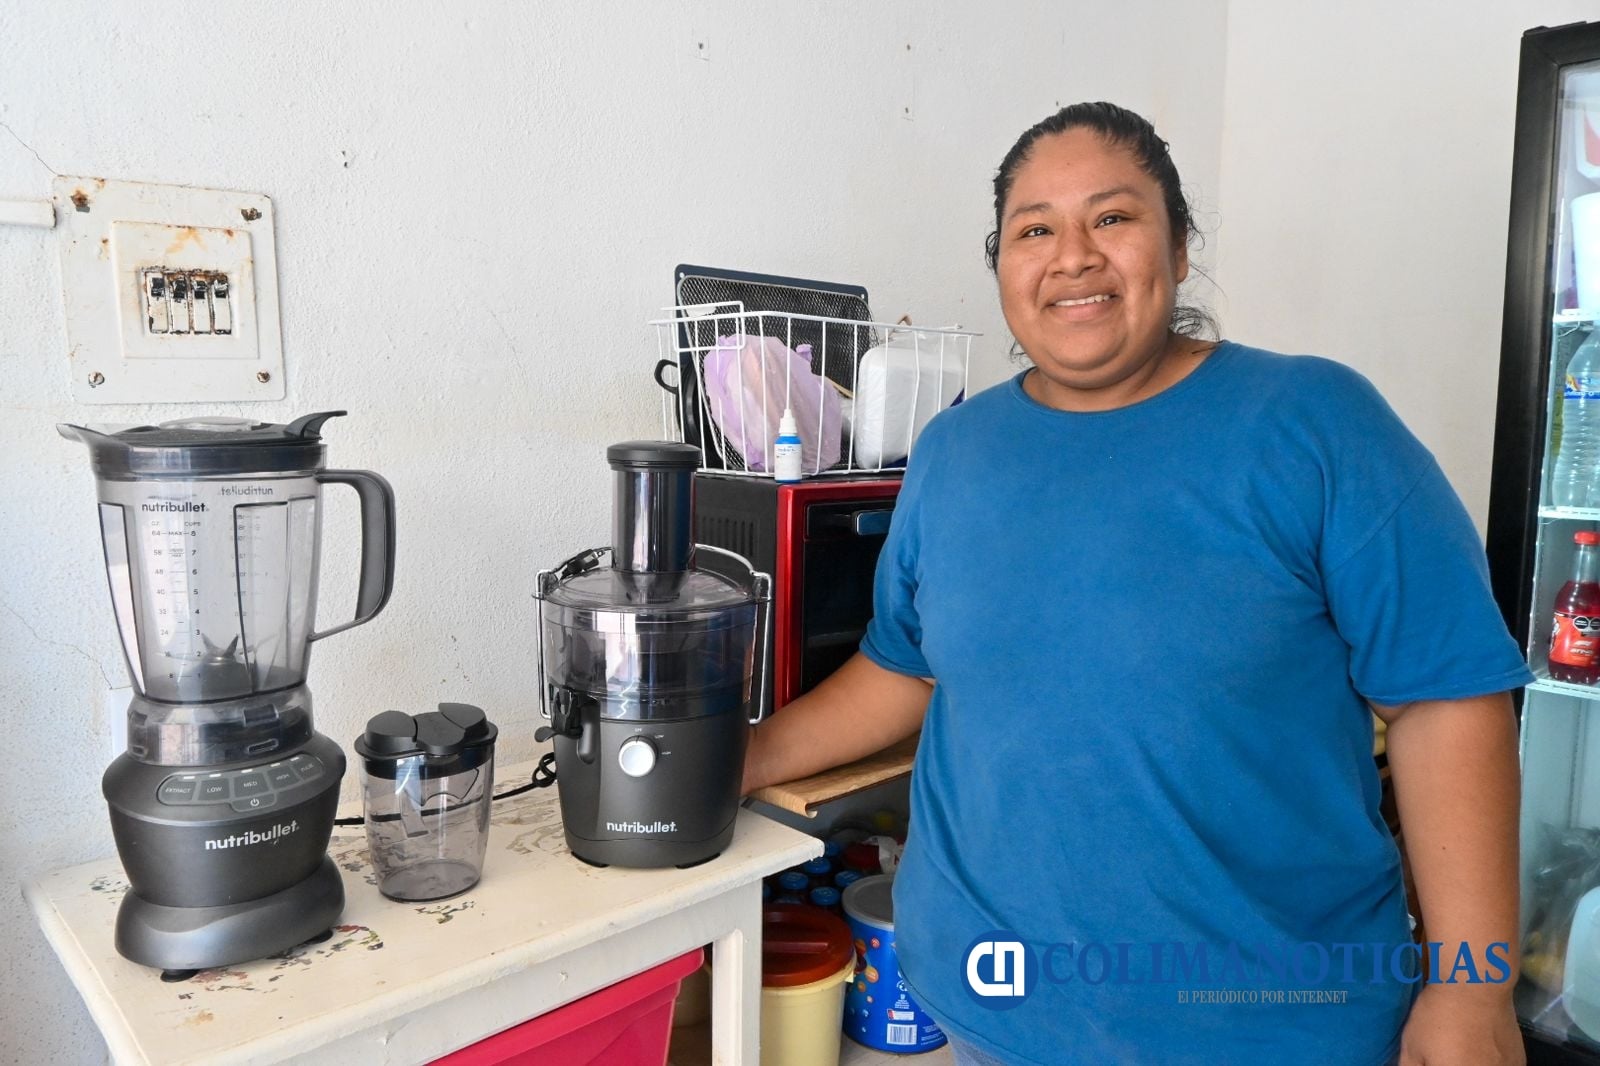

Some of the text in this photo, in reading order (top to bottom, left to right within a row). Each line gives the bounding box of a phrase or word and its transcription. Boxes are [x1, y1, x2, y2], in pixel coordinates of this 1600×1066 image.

[142, 502, 206, 512] nutribullet
[606, 821, 676, 834] nutribullet
[205, 820, 297, 850] nutribullet
